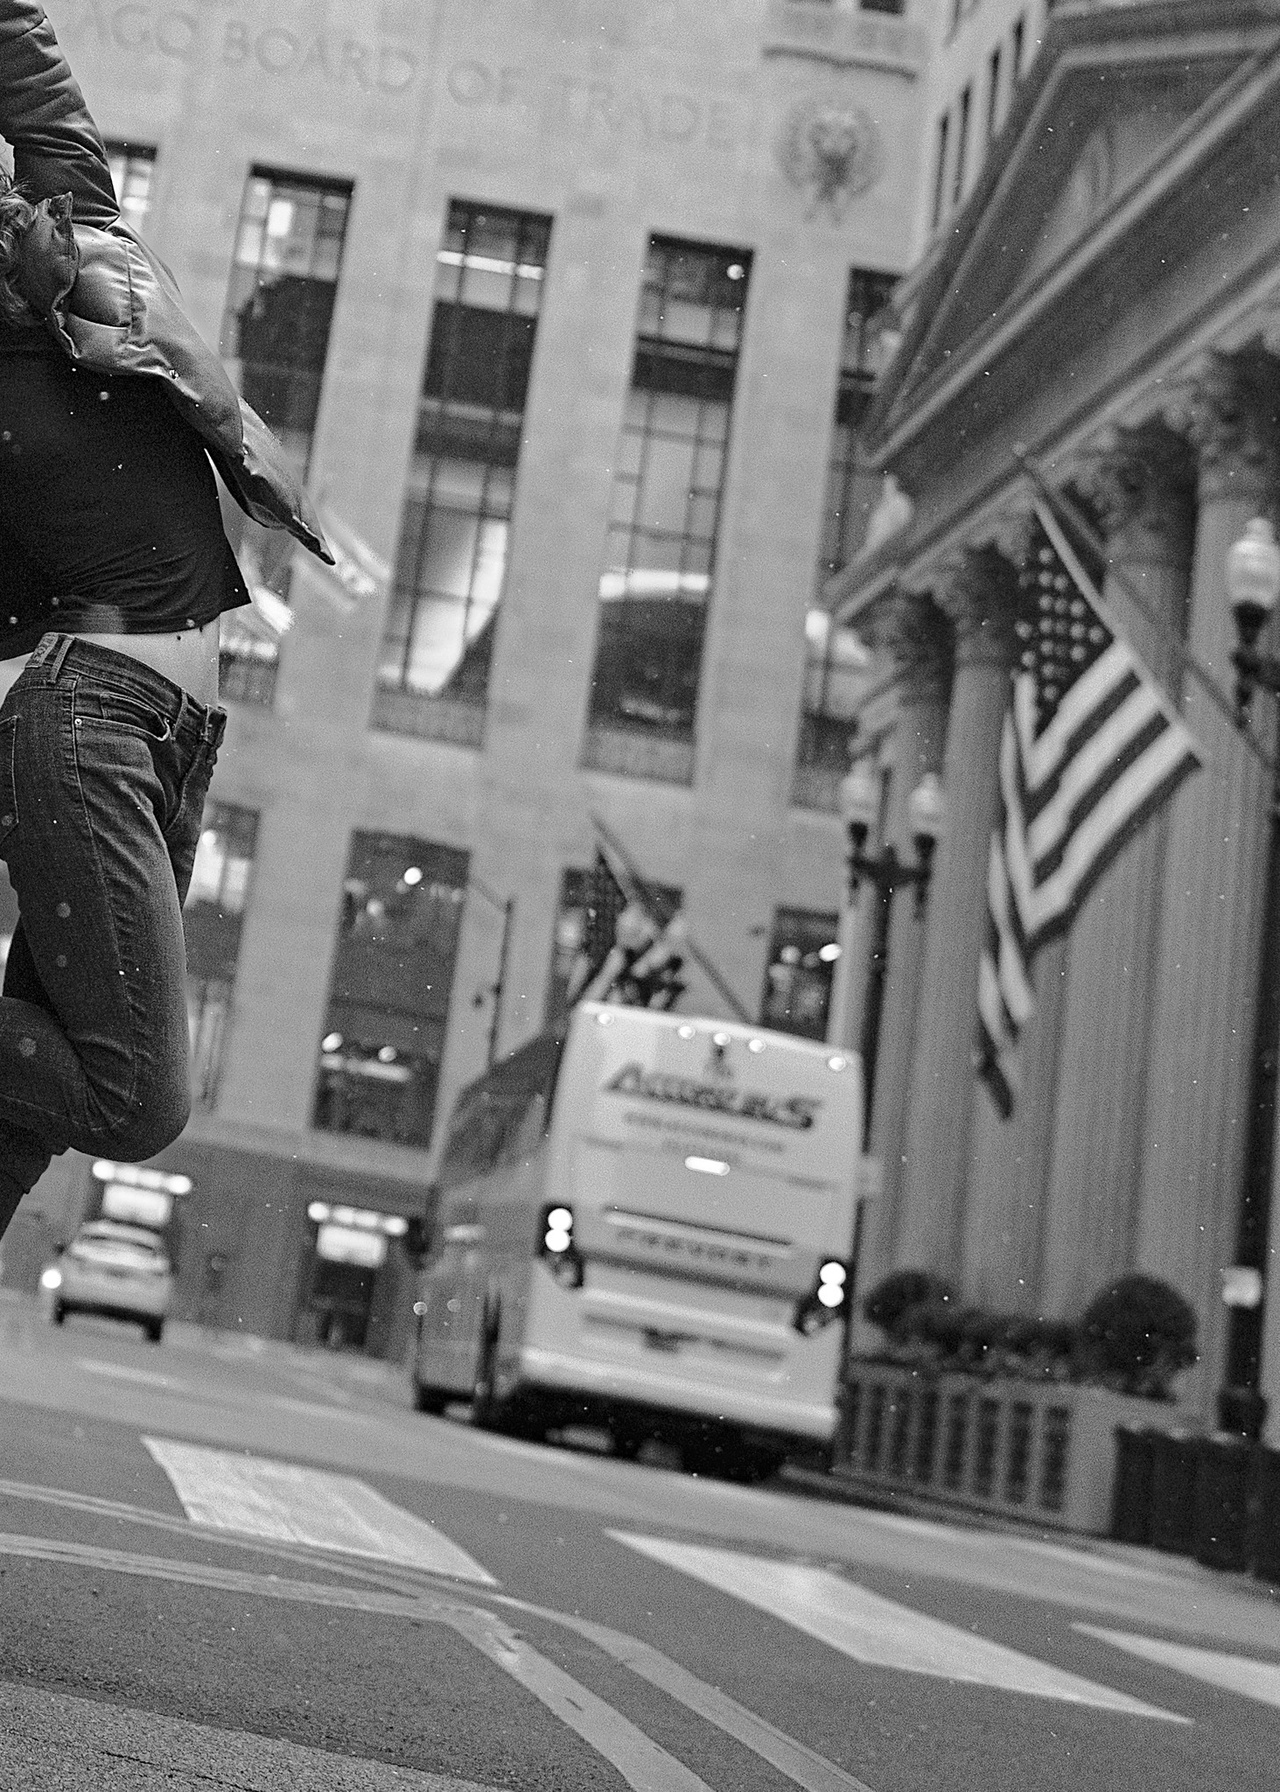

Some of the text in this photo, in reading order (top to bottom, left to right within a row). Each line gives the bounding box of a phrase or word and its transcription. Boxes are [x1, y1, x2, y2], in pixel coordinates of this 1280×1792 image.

[223, 20, 418, 95] BOARD
[447, 59, 528, 107] OF
[546, 73, 738, 152] TRADE
